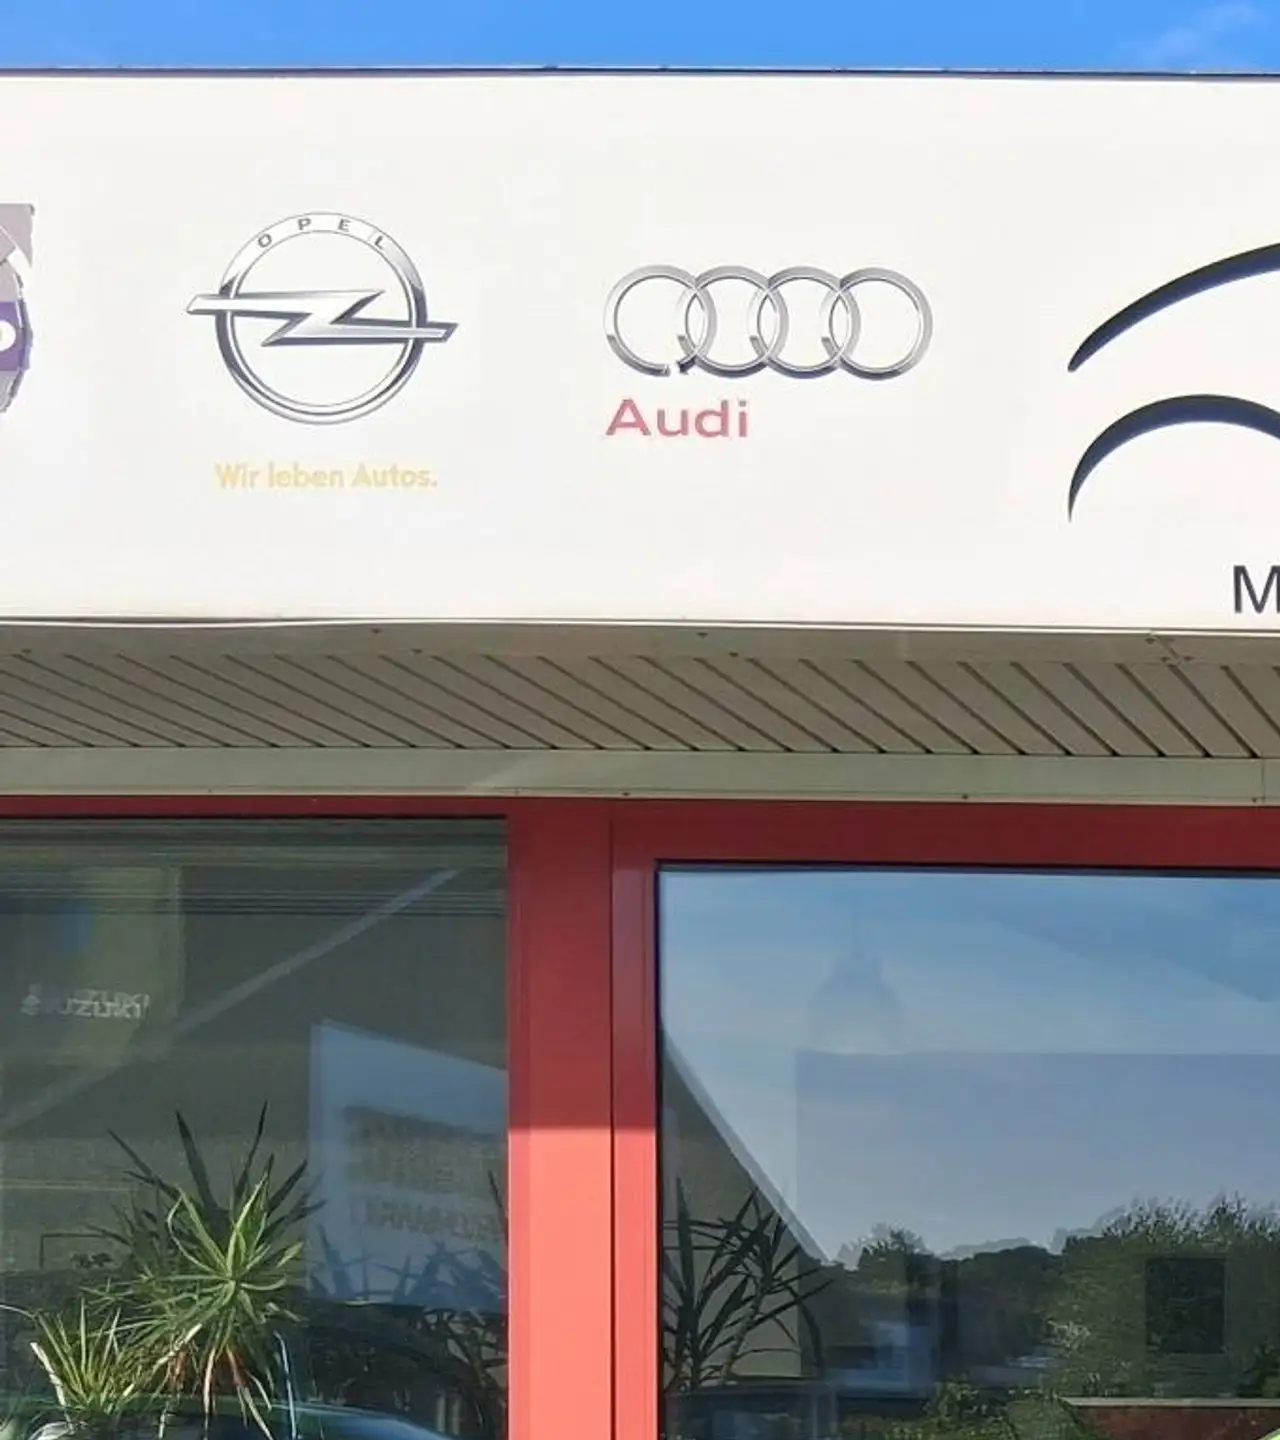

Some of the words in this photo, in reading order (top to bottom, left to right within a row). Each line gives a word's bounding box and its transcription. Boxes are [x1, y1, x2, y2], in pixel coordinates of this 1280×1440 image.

[257, 217, 386, 251] OPEL
[605, 398, 749, 439] Audi
[213, 462, 261, 489] Wir
[267, 461, 344, 489] leben
[351, 463, 440, 489] Autos.
